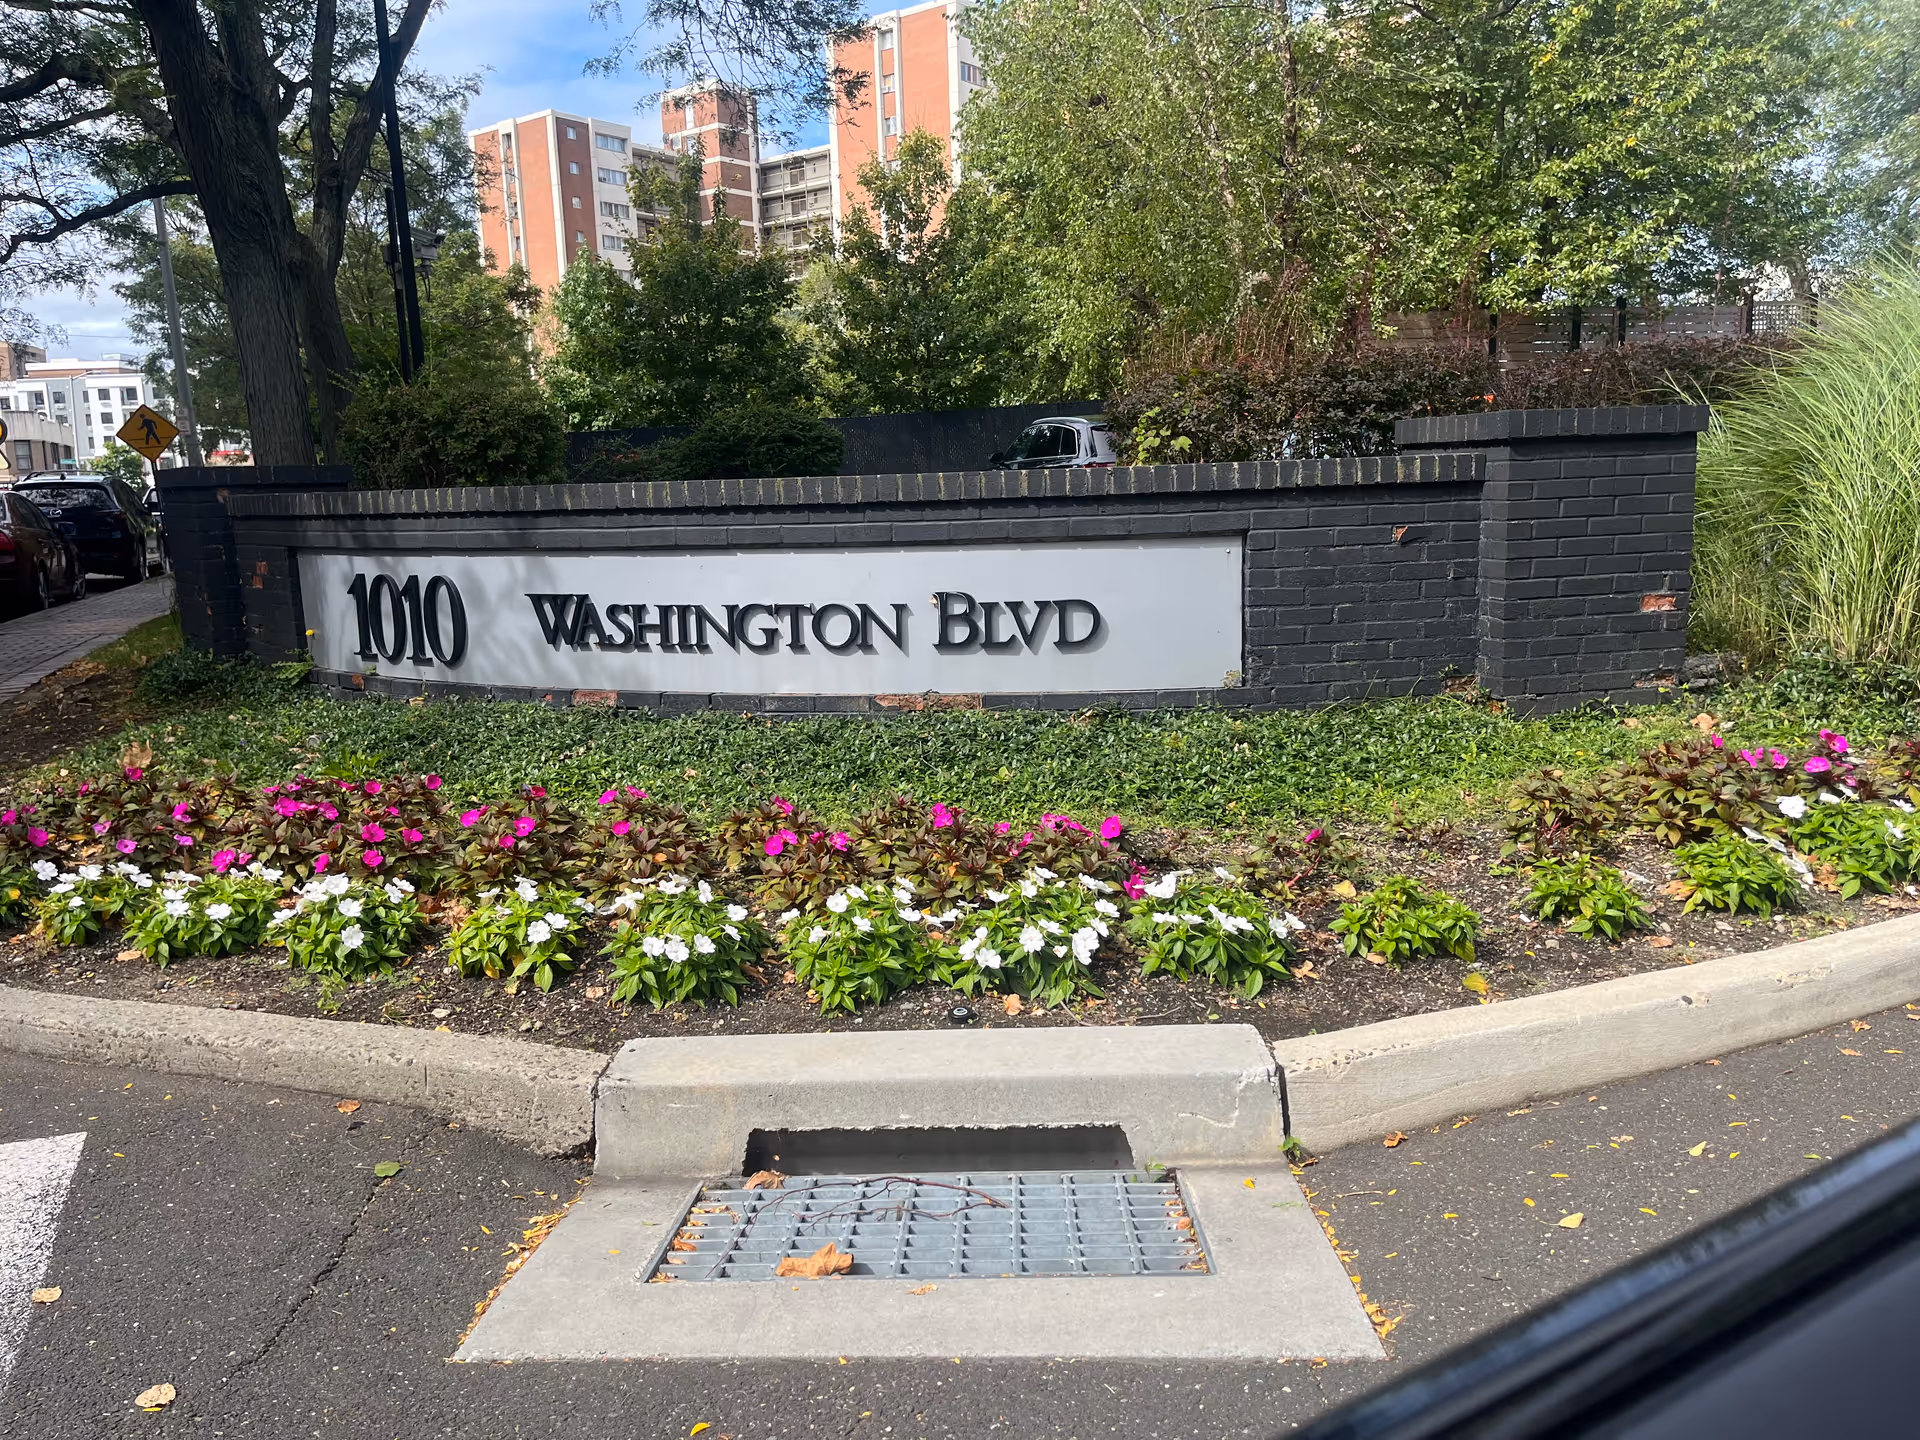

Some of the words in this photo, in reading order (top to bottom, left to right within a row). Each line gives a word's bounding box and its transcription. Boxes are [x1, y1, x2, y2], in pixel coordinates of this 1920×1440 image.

[347, 573, 467, 665] 1010
[524, 593, 906, 651] WASHINGTON
[933, 591, 1101, 648] BLVD
